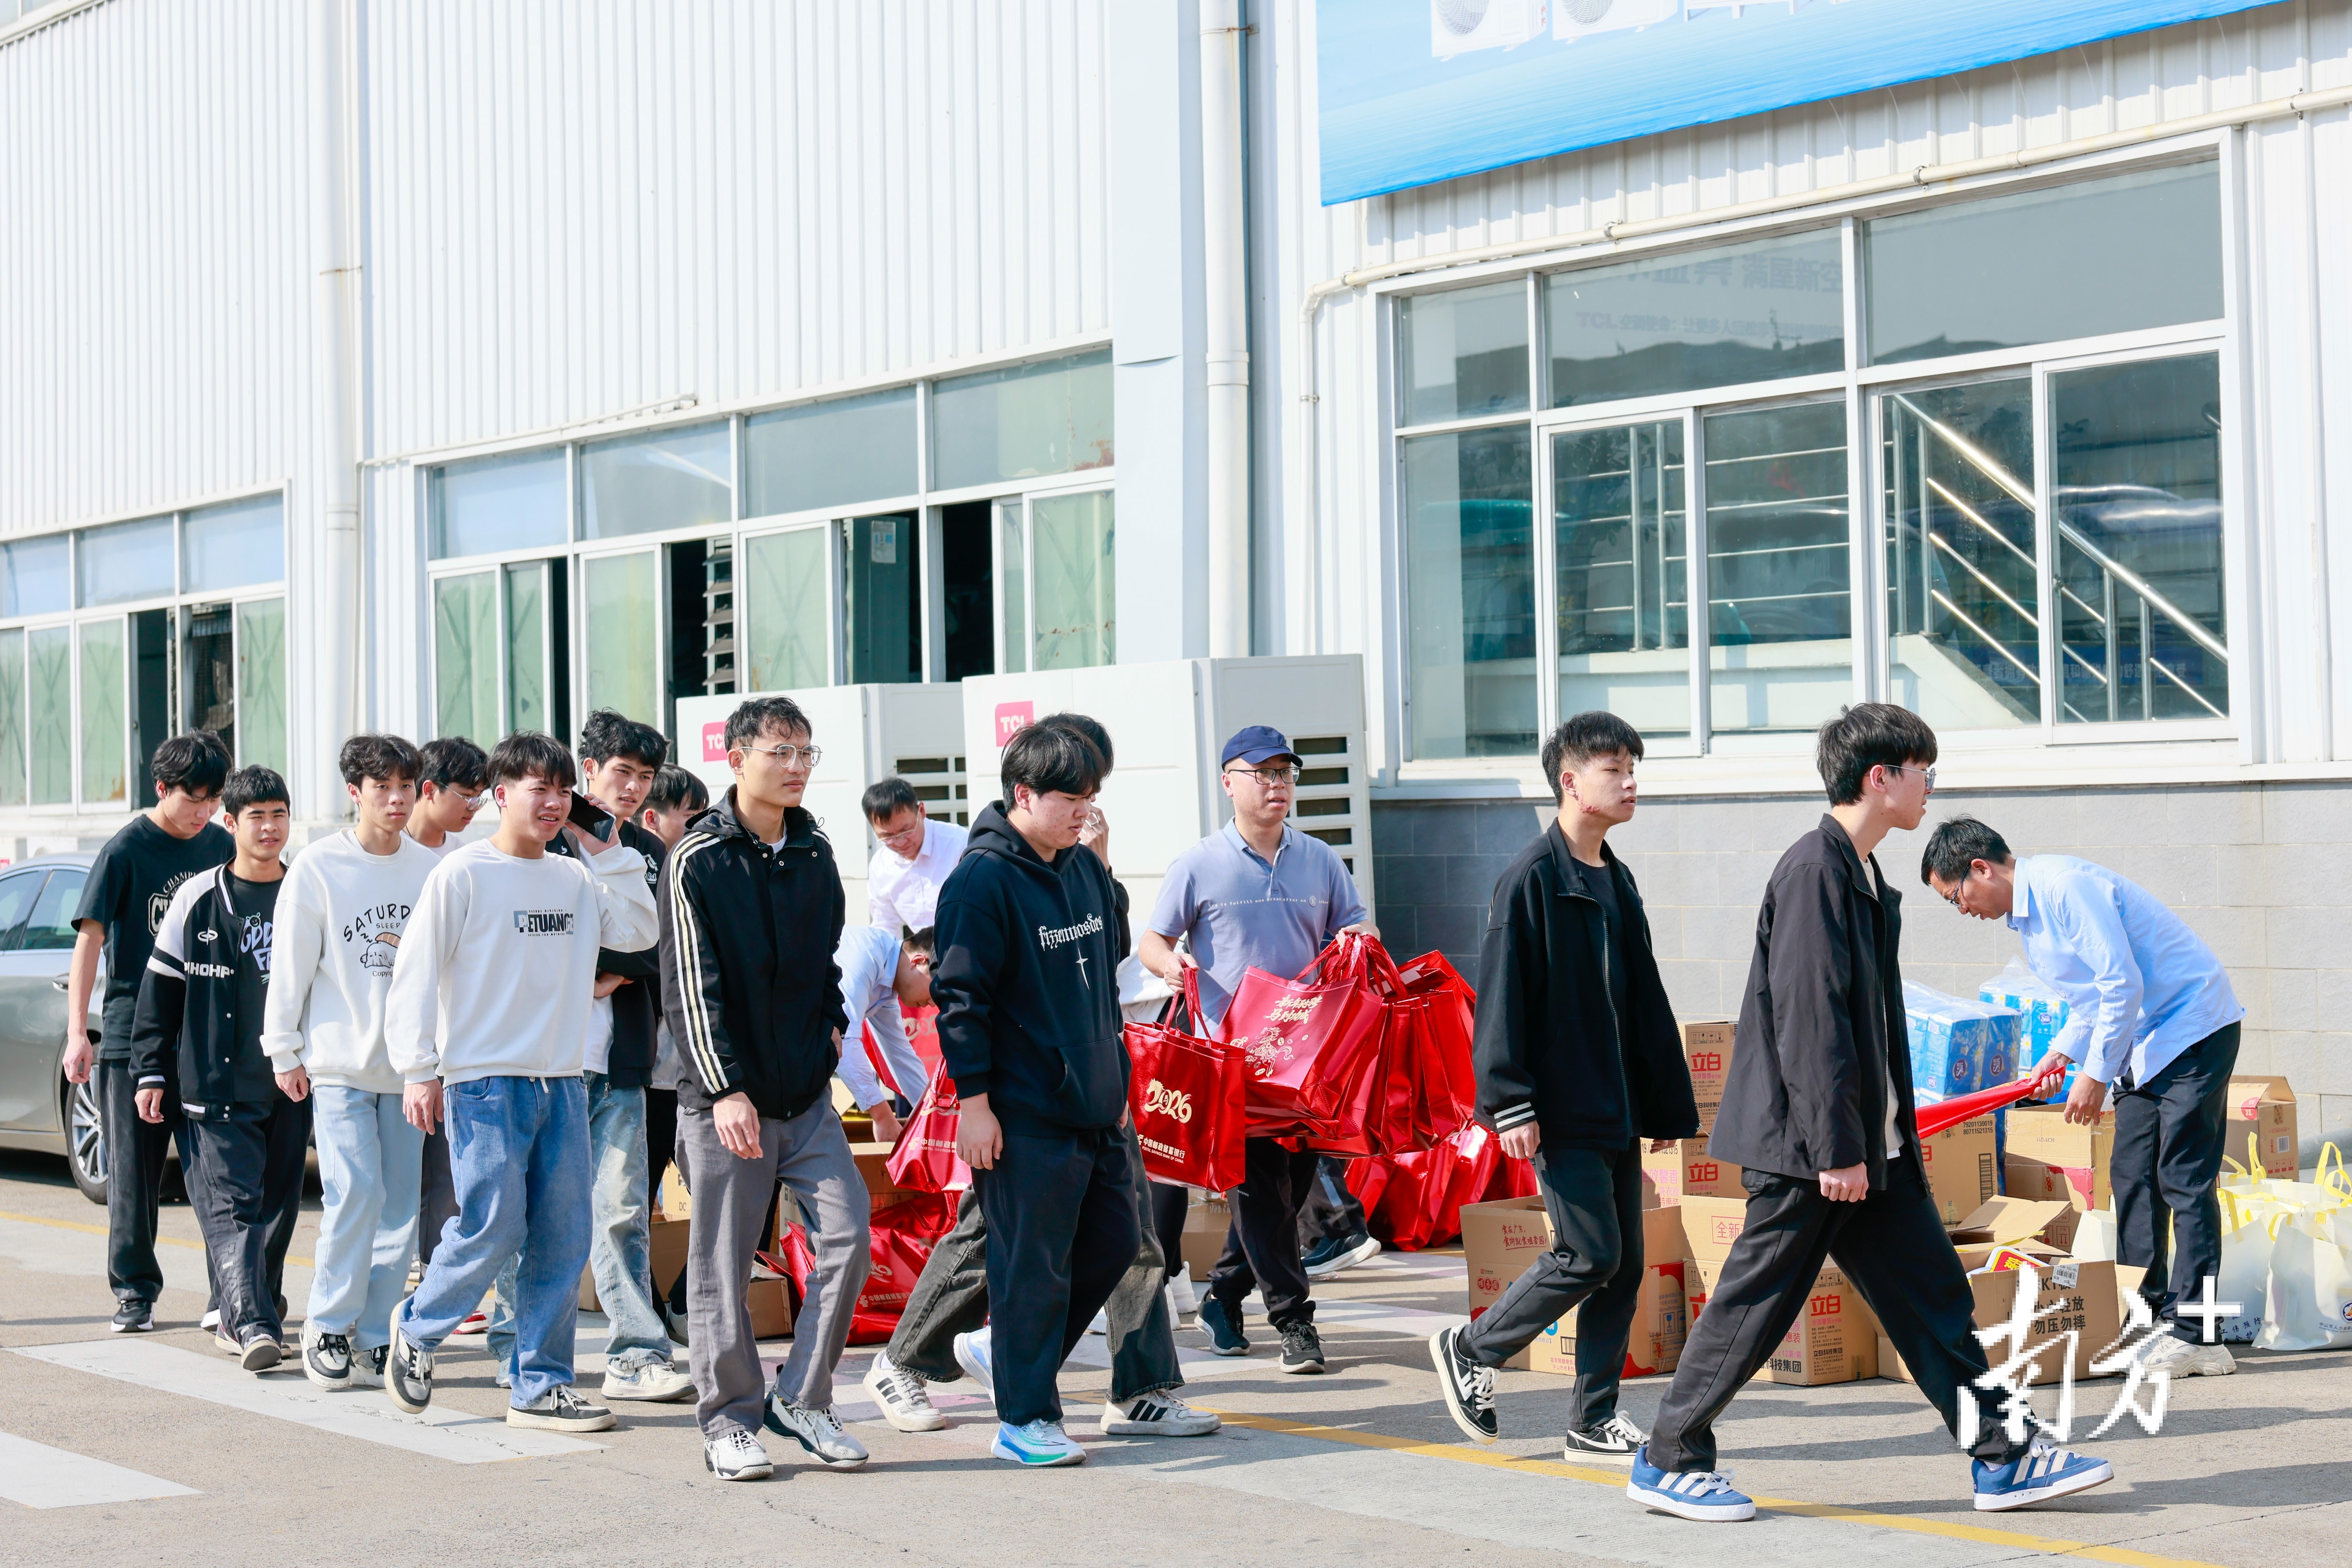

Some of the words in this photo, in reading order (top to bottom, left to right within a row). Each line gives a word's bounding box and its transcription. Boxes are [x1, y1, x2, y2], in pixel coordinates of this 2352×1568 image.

[1576, 311, 1617, 329] TCL
[706, 733, 725, 750] TC
[163, 871, 196, 894] CHAMP
[1691, 1052, 1721, 1072] 立白
[1144, 1078, 1192, 1123] 2026
[1143, 1137, 1185, 1159] 中国邮政储蓄银行
[1151, 1148, 1163, 1157] SAVINGS
[1642, 1168, 1679, 1184] 全效馨香
[1688, 1162, 1718, 1183] 立白
[1659, 1186, 1679, 1197] 洗衣液
[1659, 1197, 1679, 1207] 特惠装
[1810, 1294, 1841, 1317] 立白
[2034, 1314, 2086, 1335] 勿压勿摔
[2319, 1322, 2352, 1331] 中山市人力资源
[1782, 1332, 1800, 1343] 惠装
[1761, 1358, 1801, 1373] 科技集团
